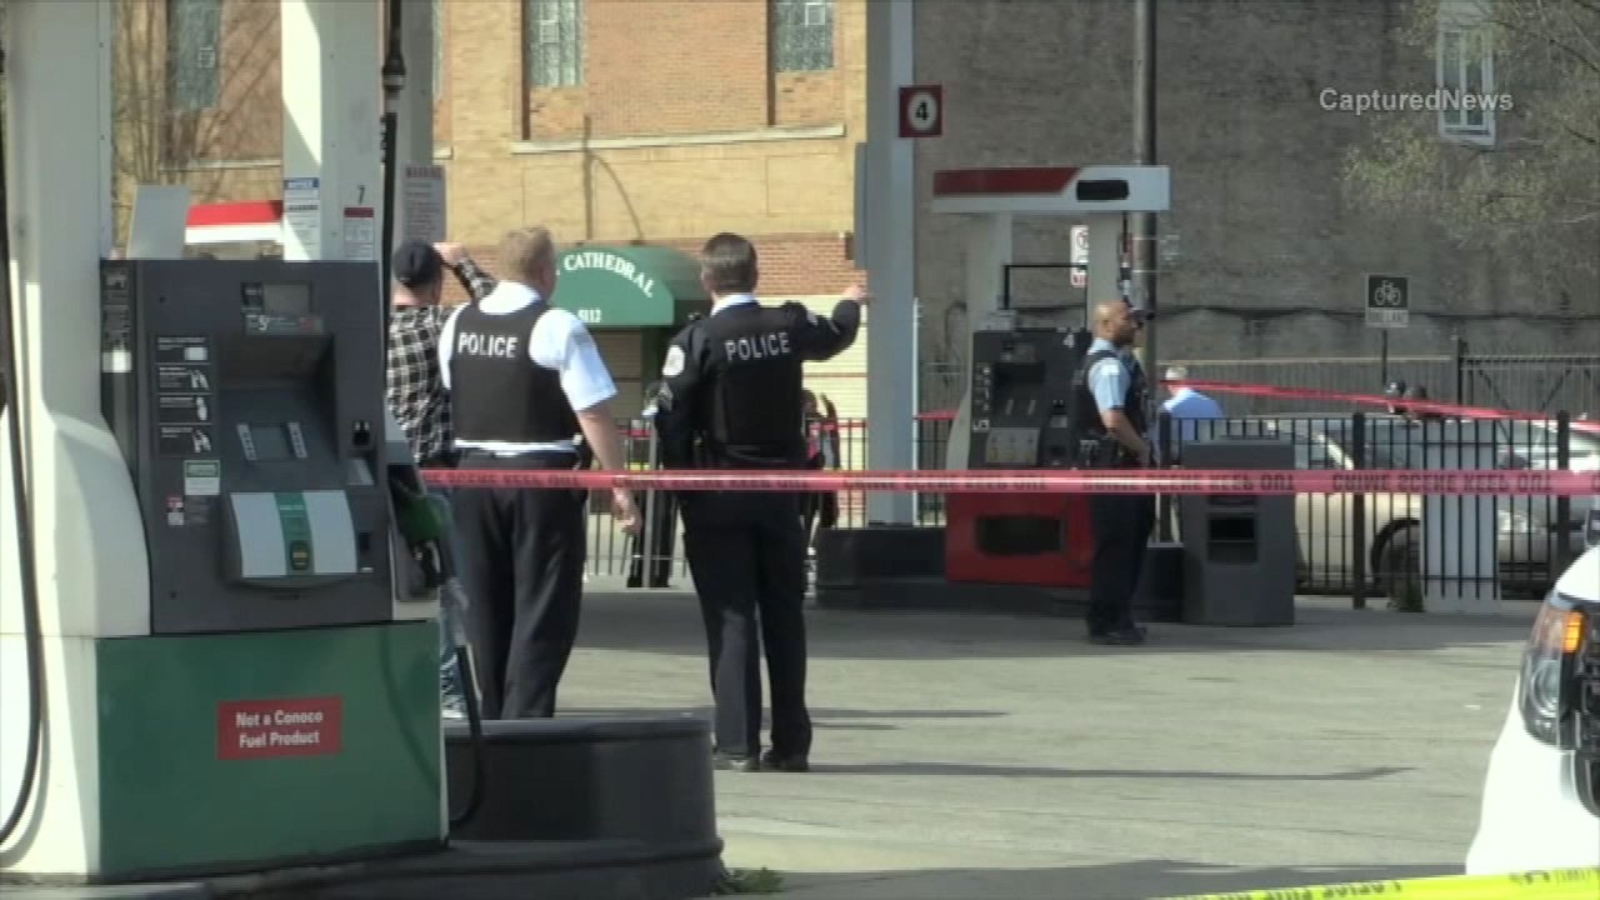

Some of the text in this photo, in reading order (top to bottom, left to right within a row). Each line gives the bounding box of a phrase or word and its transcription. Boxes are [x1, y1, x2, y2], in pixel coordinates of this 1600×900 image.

[914, 101, 930, 121] 4
[563, 251, 654, 298] CATHEDRAL
[457, 331, 519, 358] POLICE
[724, 331, 791, 362] POLICE
[235, 709, 323, 728] Not a Conoco
[239, 729, 320, 748] Fuel Product
